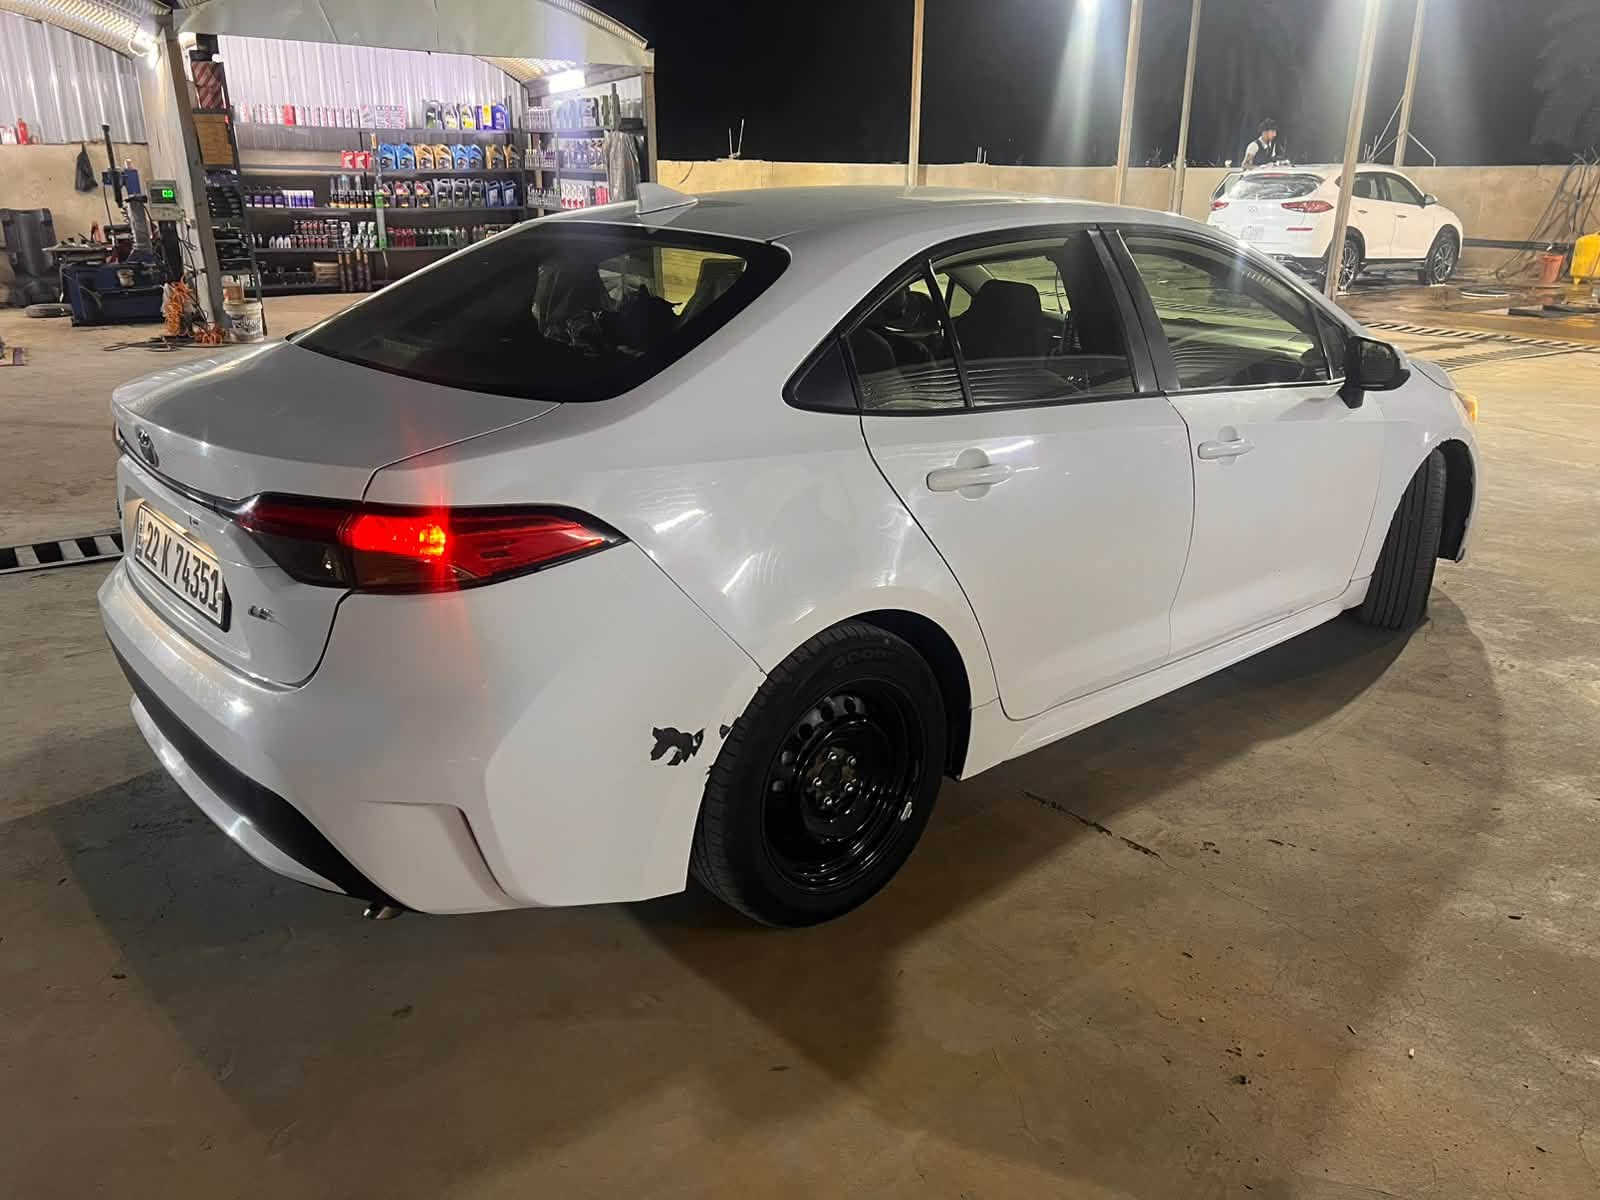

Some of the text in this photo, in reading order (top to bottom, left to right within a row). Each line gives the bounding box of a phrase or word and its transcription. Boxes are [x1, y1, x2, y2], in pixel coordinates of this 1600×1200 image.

[144, 521, 160, 567] 22
[161, 534, 172, 577] K
[174, 543, 219, 614] 74351
